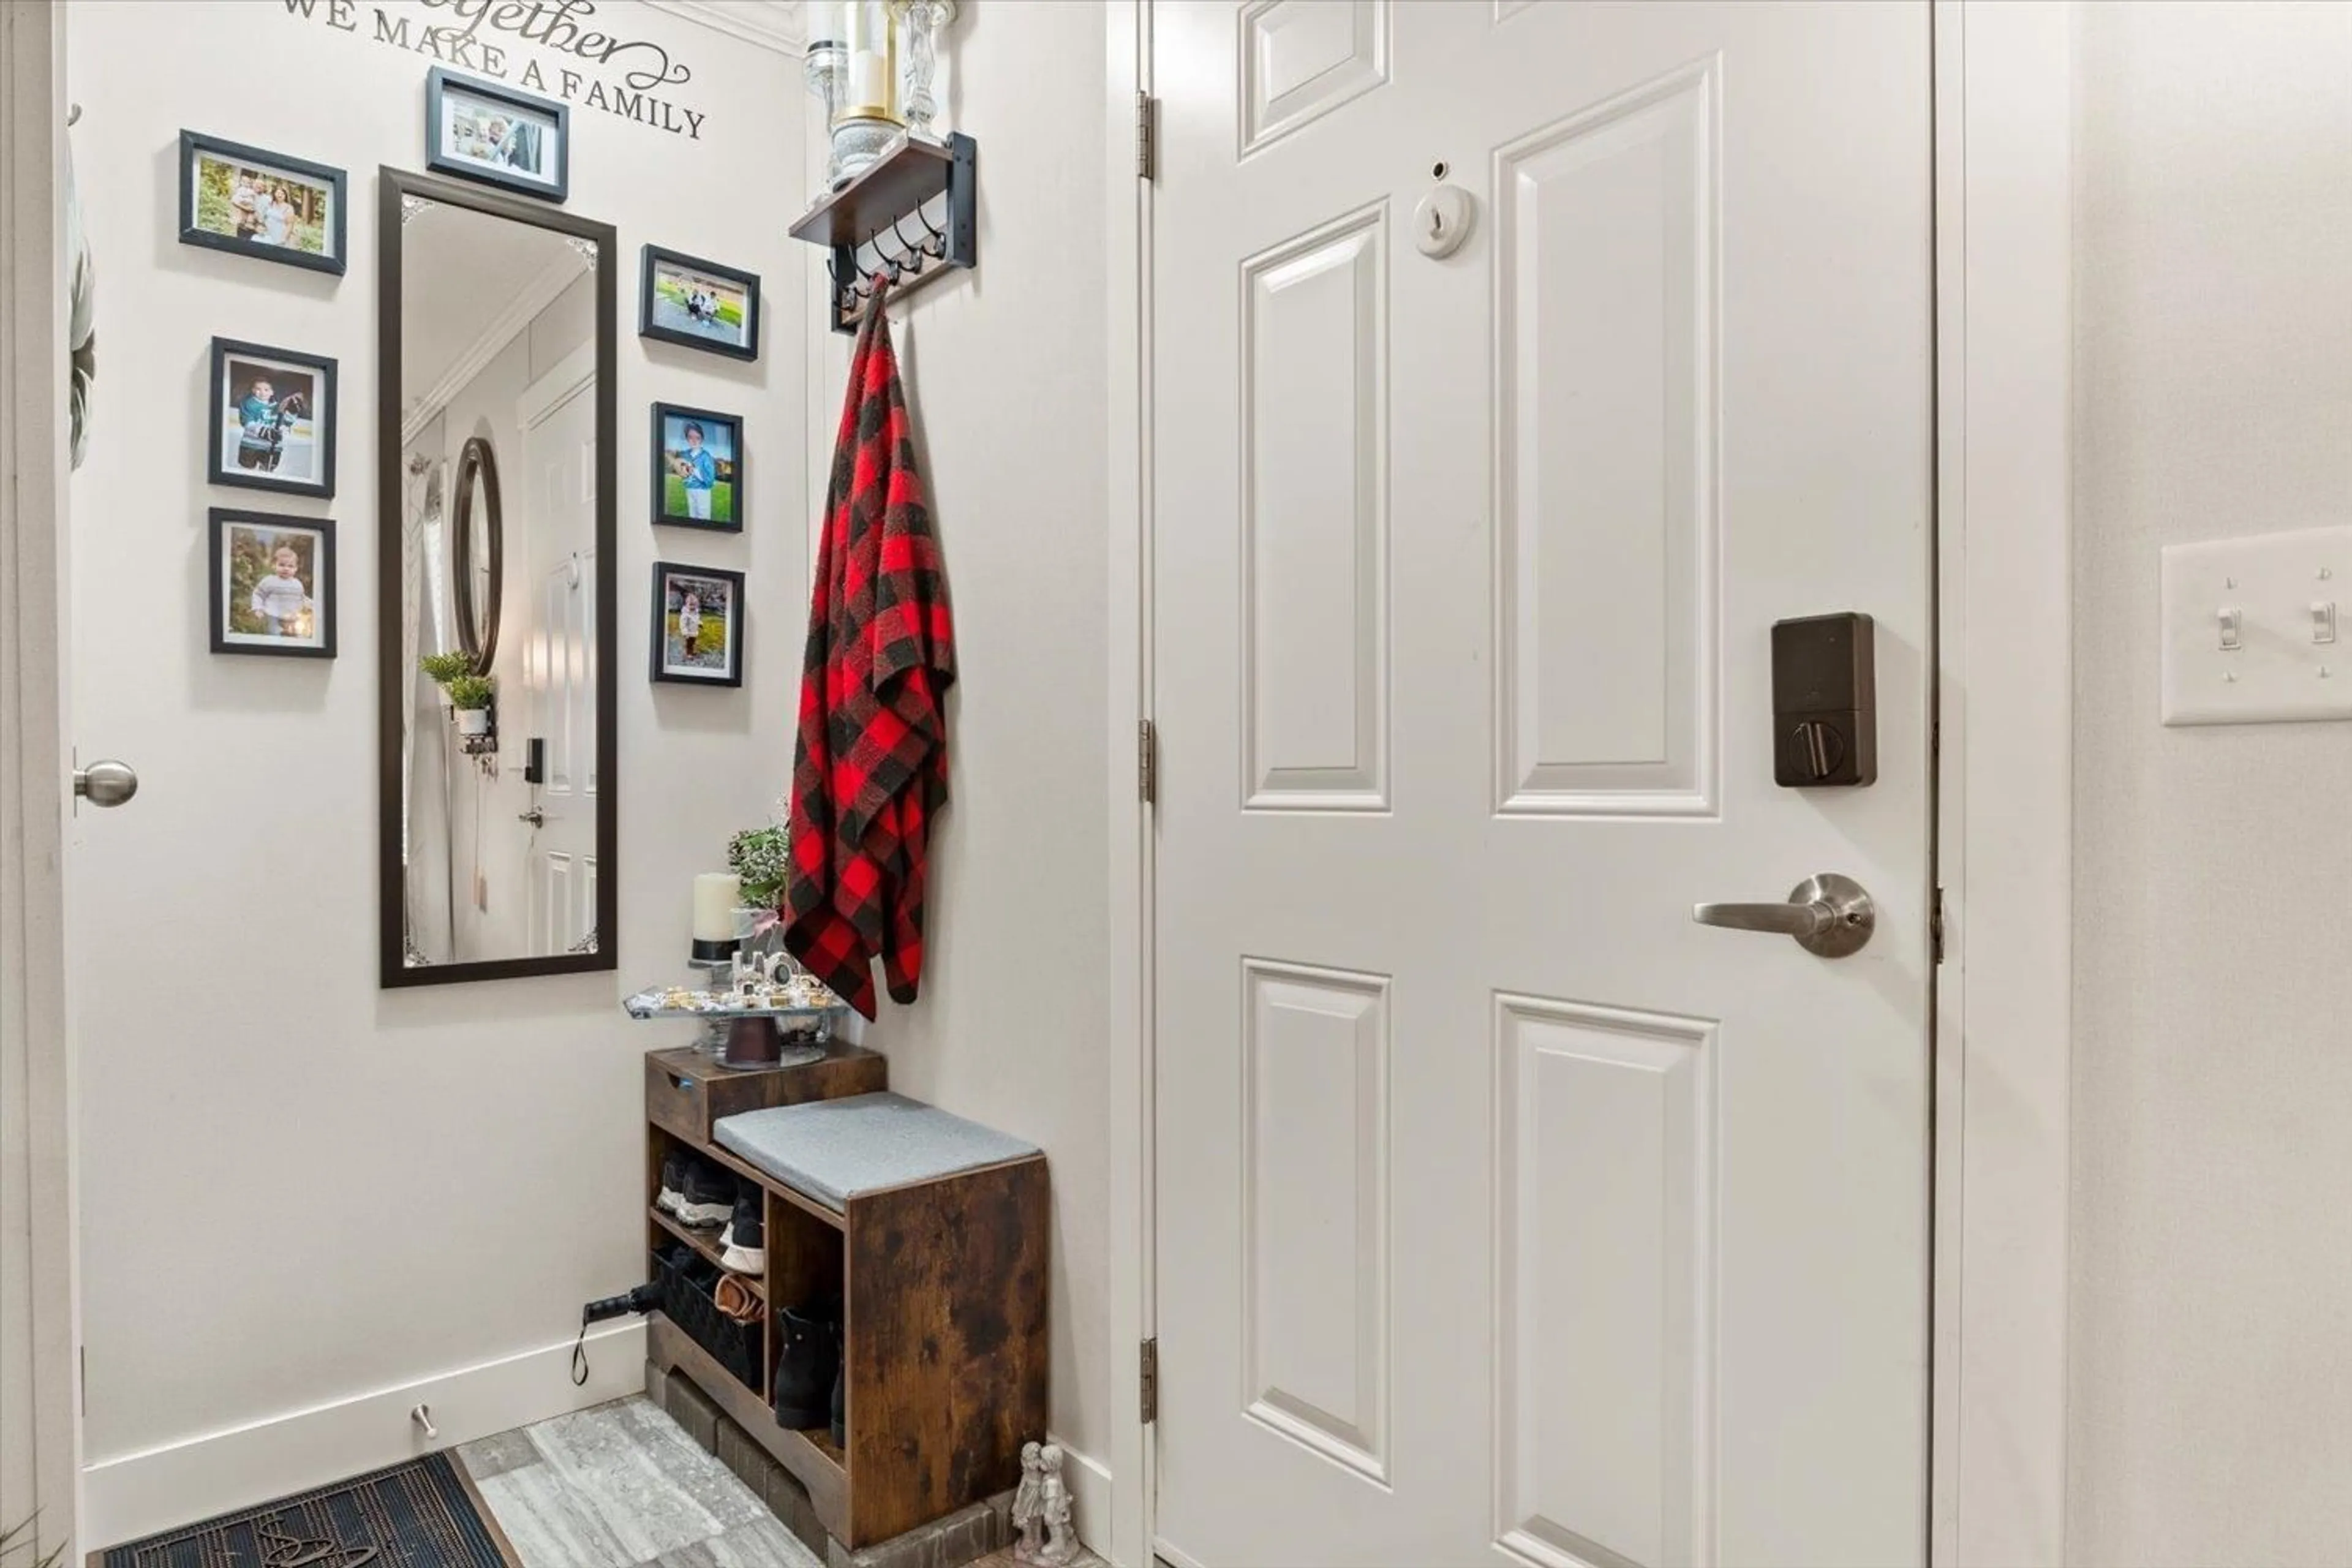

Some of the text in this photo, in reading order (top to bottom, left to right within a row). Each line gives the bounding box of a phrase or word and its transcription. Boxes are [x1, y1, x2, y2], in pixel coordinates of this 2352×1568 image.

[373, 9, 508, 78] MAKE
[521, 58, 548, 92] A
[560, 69, 705, 140] FAMILY
[418, 0, 691, 89] gether
